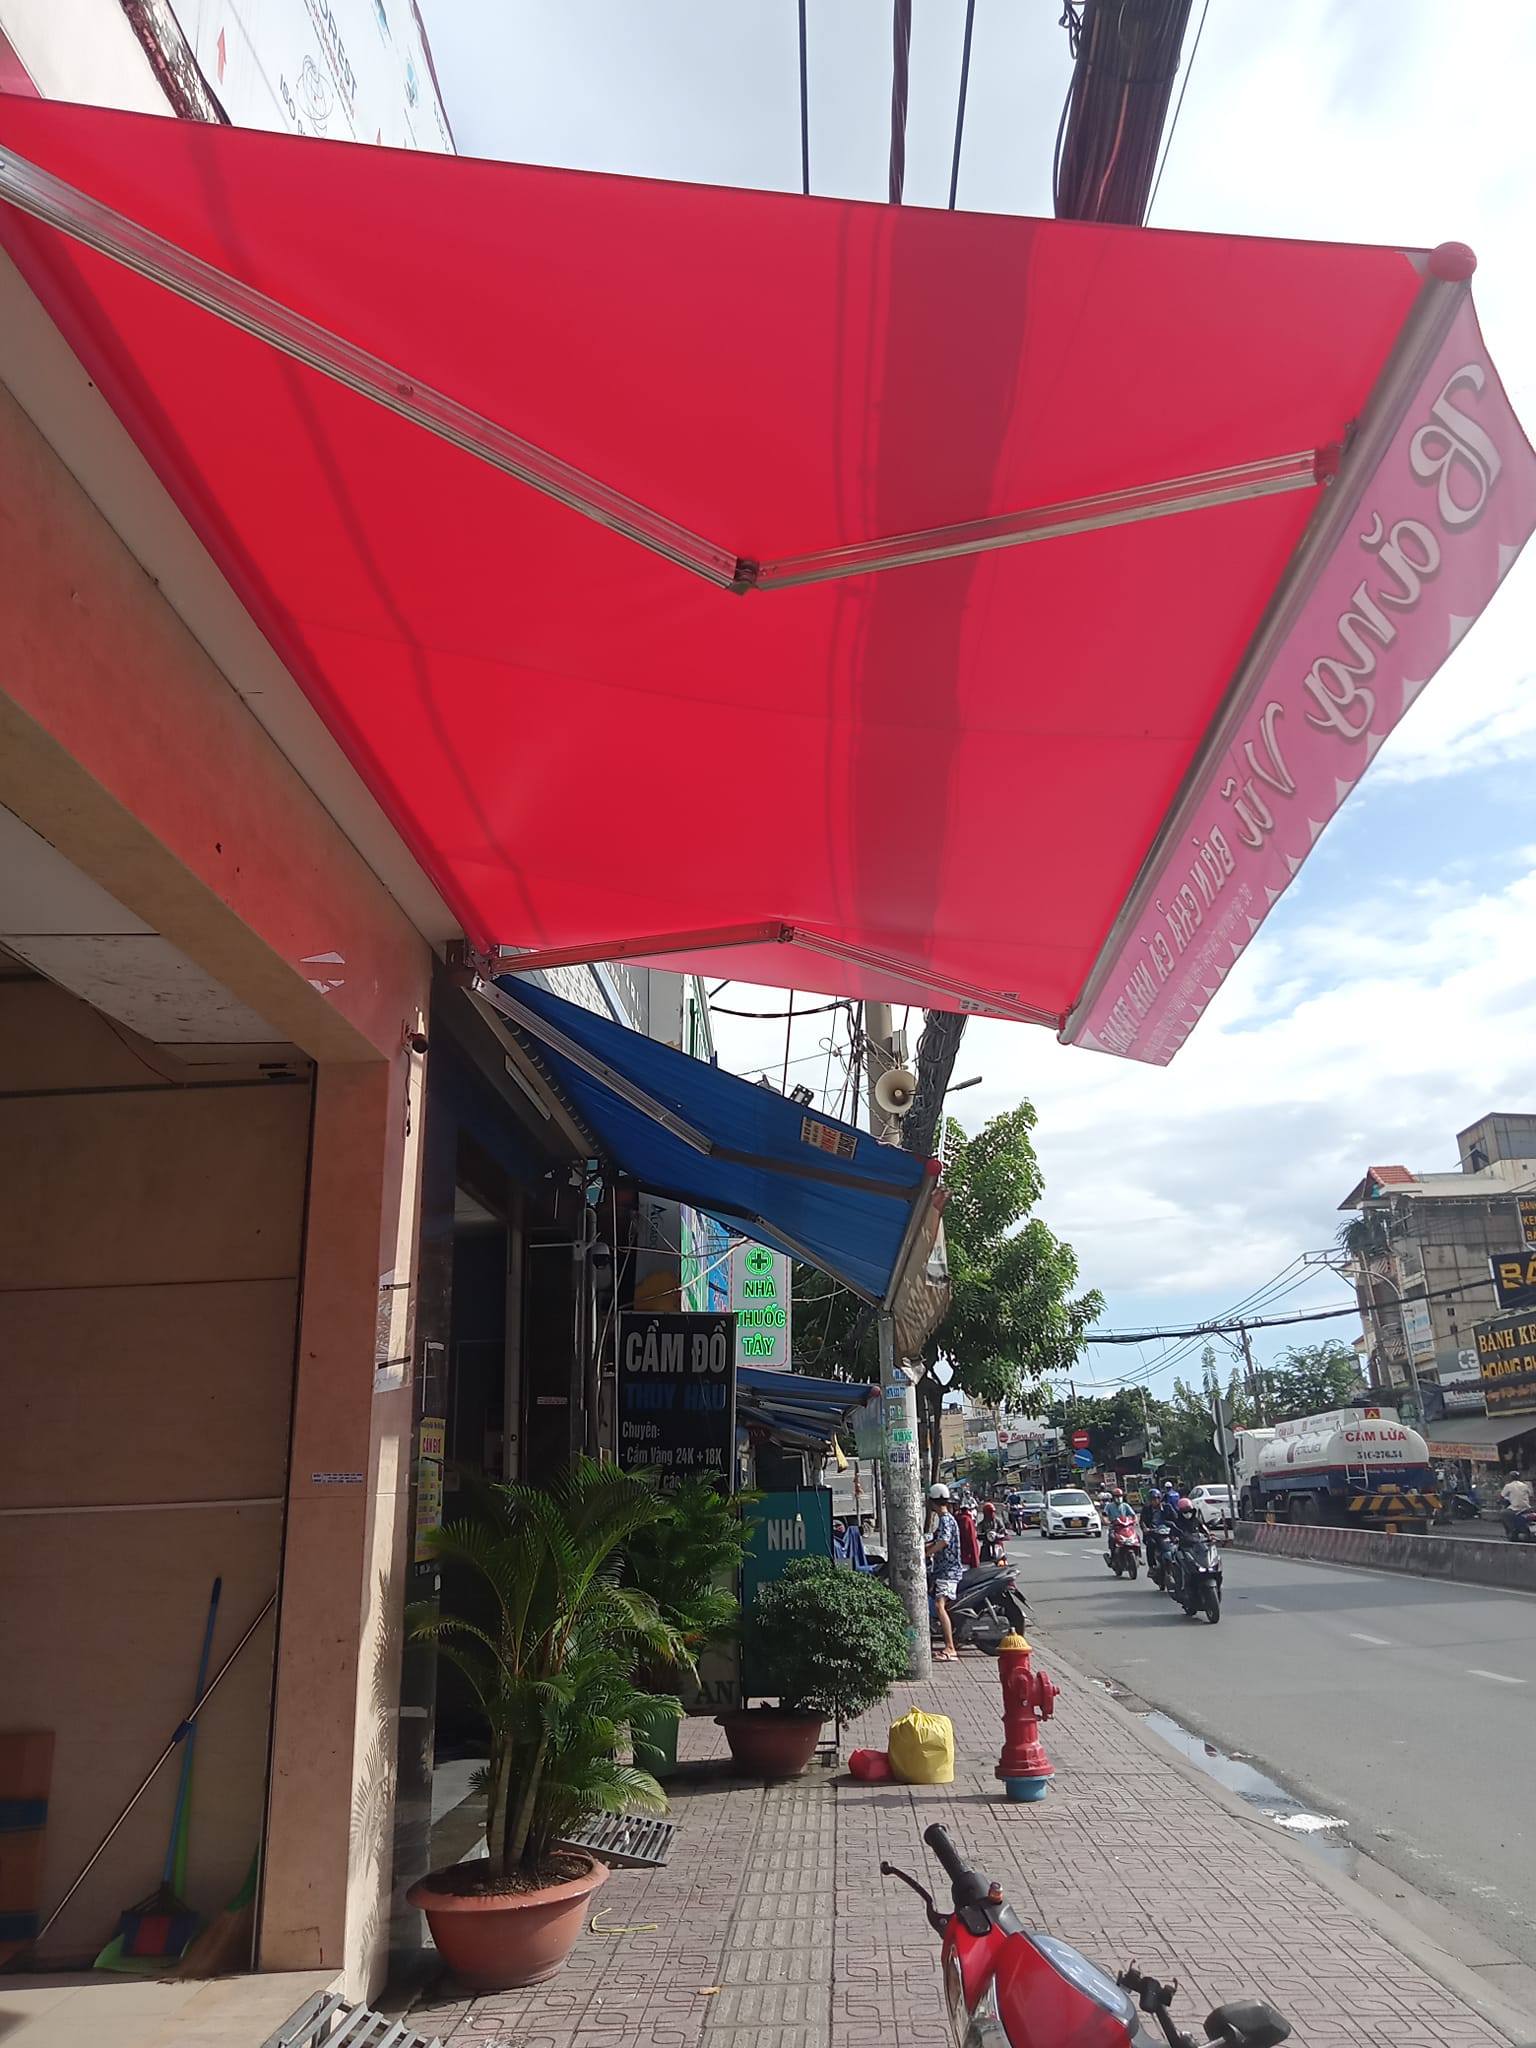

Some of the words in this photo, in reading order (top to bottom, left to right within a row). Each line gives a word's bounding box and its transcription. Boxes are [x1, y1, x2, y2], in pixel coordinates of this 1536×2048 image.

[744, 1276, 776, 1298] NHÀ
[733, 1303, 787, 1328] THUỐC
[626, 1320, 684, 1373] CẦM
[691, 1320, 726, 1373] ĐỒ
[742, 1333, 776, 1356] TÂY
[1478, 1325, 1516, 1353] BÁNH
[622, 1421, 661, 1441] Chuyên:
[1380, 1428, 1407, 1442] LỬA
[627, 1444, 648, 1463] Cầm
[650, 1446, 673, 1466] Vàng
[676, 1447, 694, 1465] 24K
[705, 1447, 722, 1465] 18K
